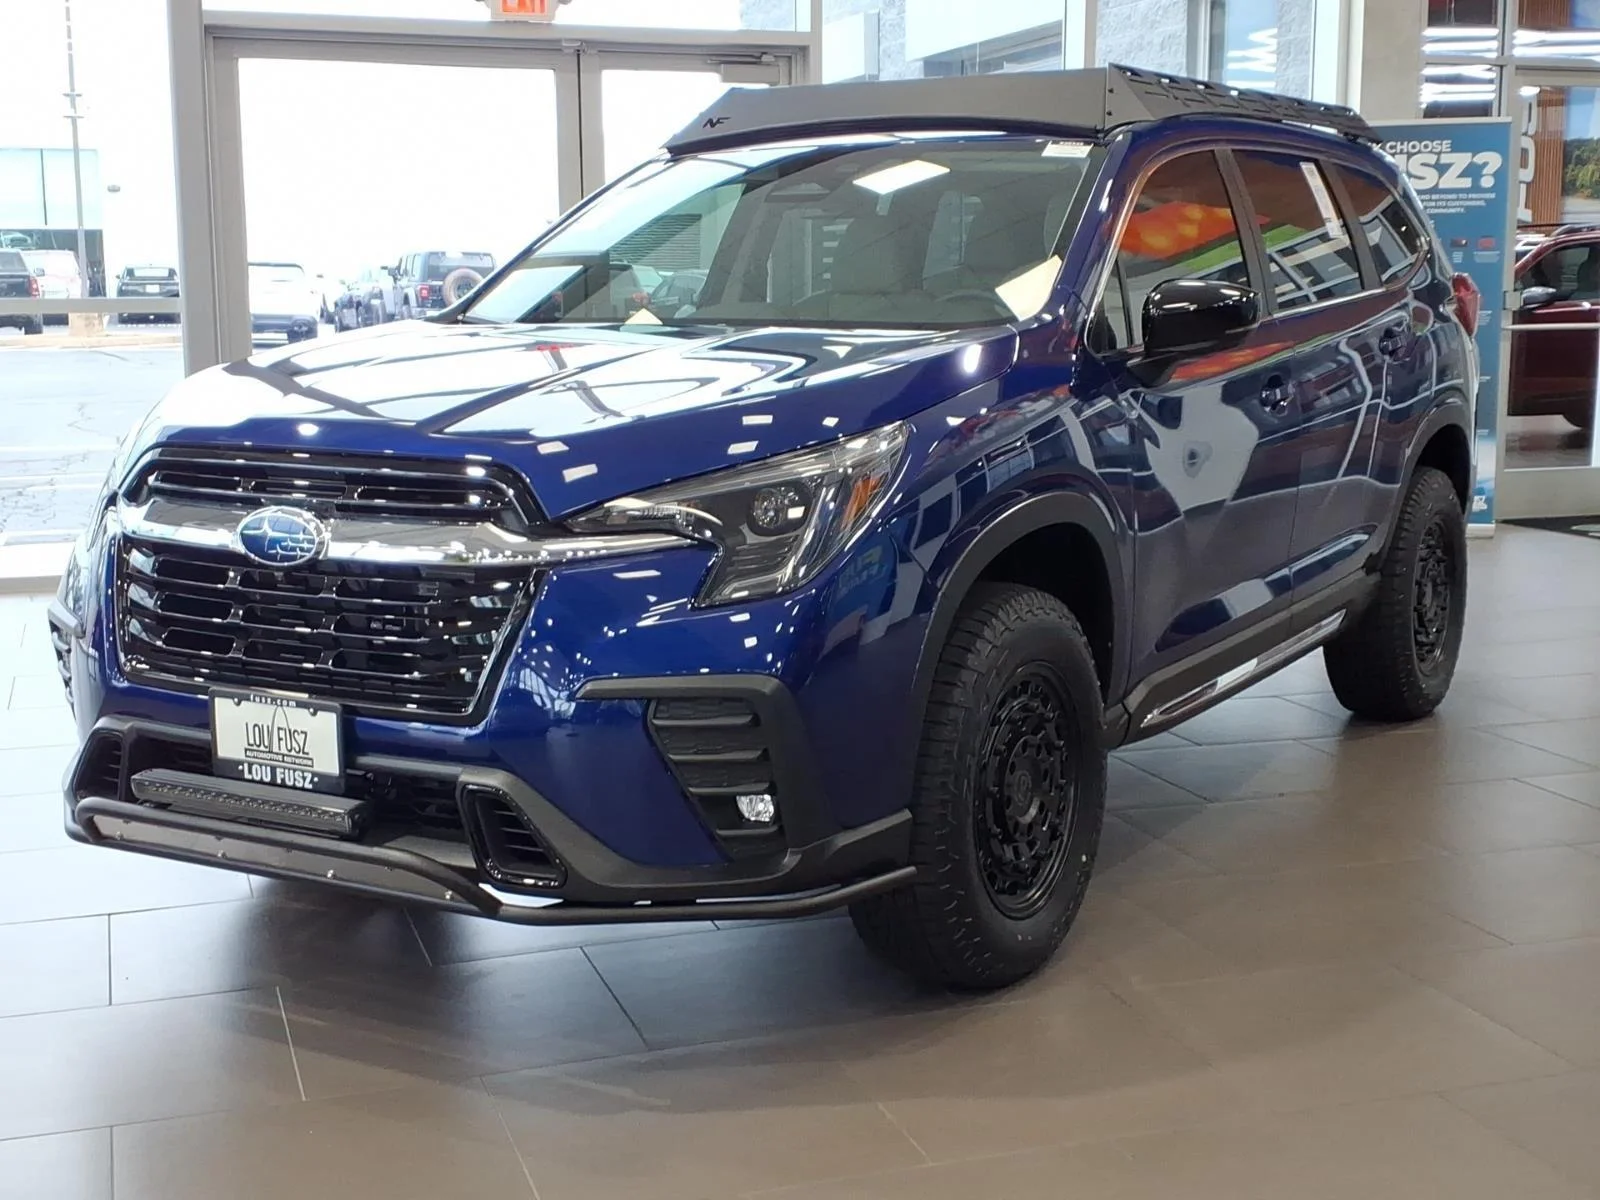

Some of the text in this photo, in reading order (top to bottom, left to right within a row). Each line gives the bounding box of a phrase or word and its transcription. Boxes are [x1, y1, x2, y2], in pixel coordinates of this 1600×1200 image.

[1385, 140, 1452, 153] CHOOSE
[245, 721, 310, 756] LOU FUSZ
[245, 750, 283, 761] AUTOMOTIVE
[243, 762, 313, 789] LOU FUSZ
